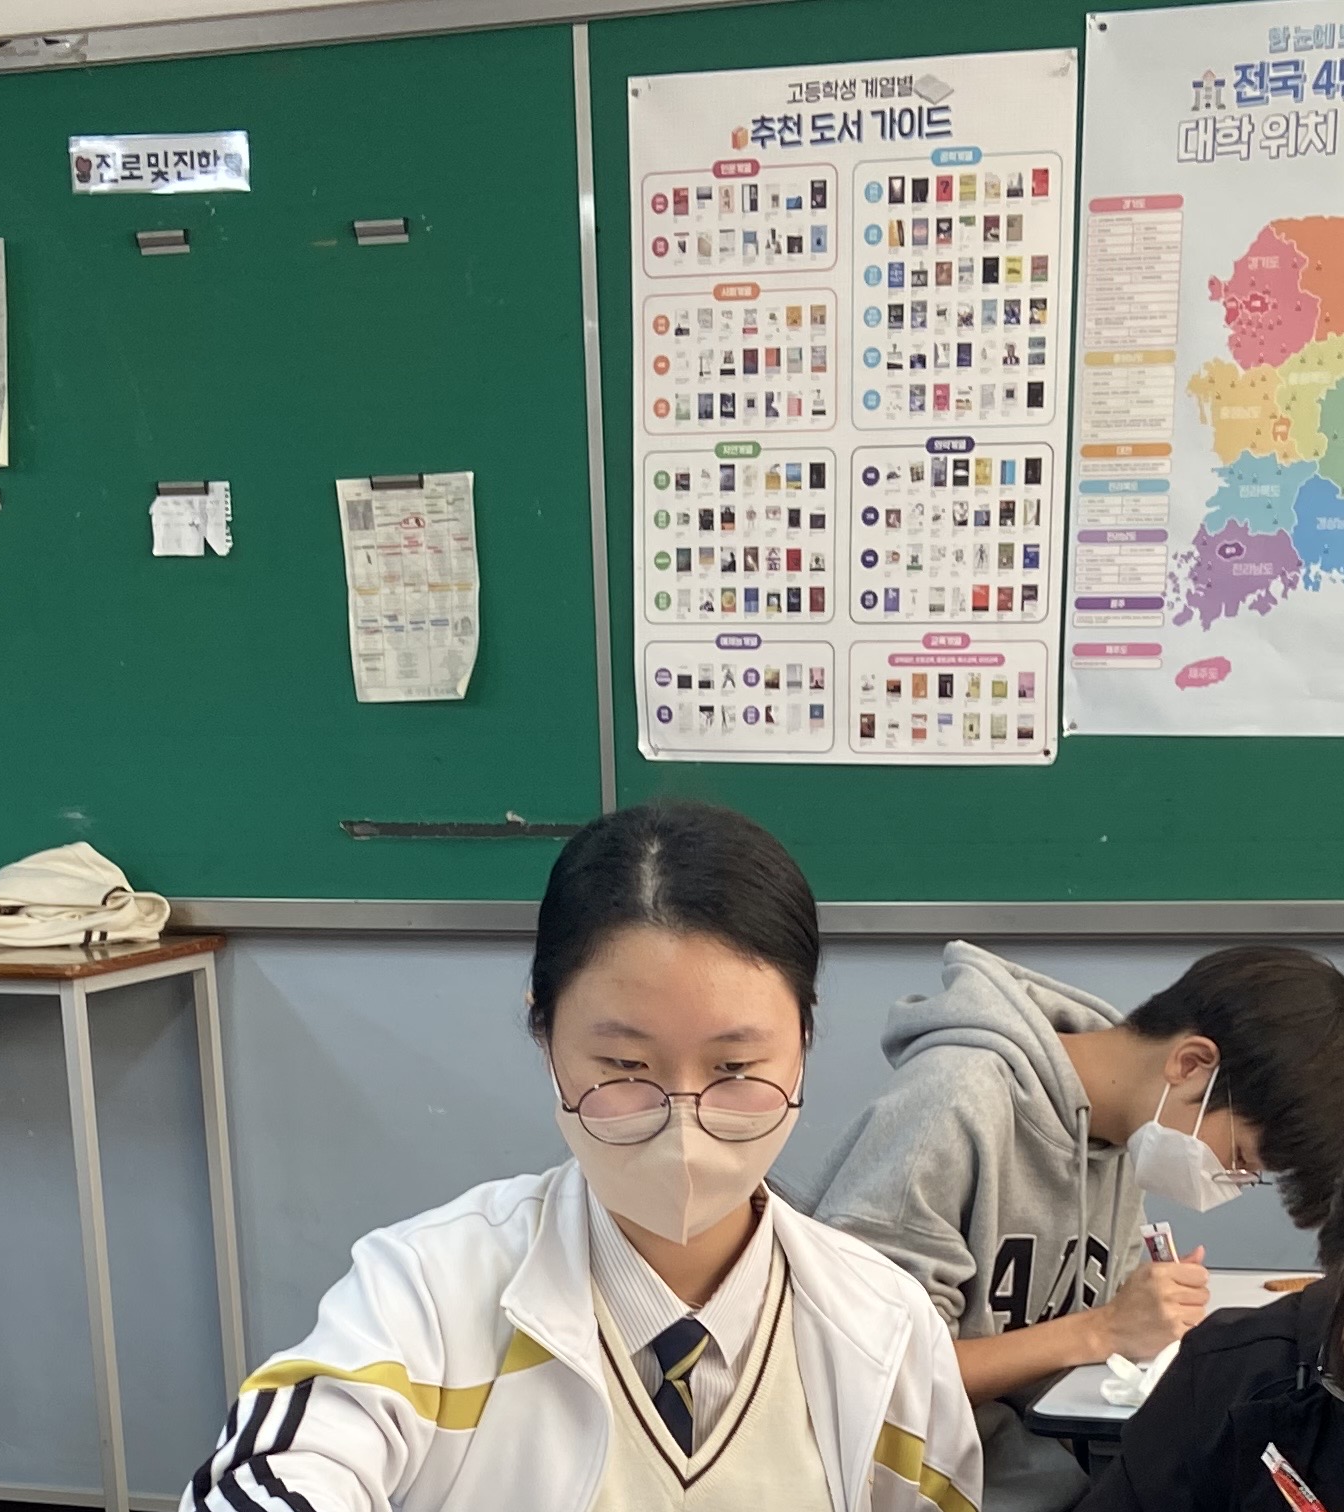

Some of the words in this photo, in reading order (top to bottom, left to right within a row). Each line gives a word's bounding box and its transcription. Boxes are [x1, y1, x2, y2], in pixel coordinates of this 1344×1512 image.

[1293, 23, 1335, 51] 눈에
[787, 79, 857, 105] 고등학생
[861, 74, 914, 99] 계열별
[1233, 59, 1306, 108] 전국
[750, 113, 803, 150] 추천
[809, 110, 863, 146] 도서
[870, 105, 952, 141] 가이드
[1177, 114, 1255, 164] 대학
[1260, 108, 1338, 160] 위치
